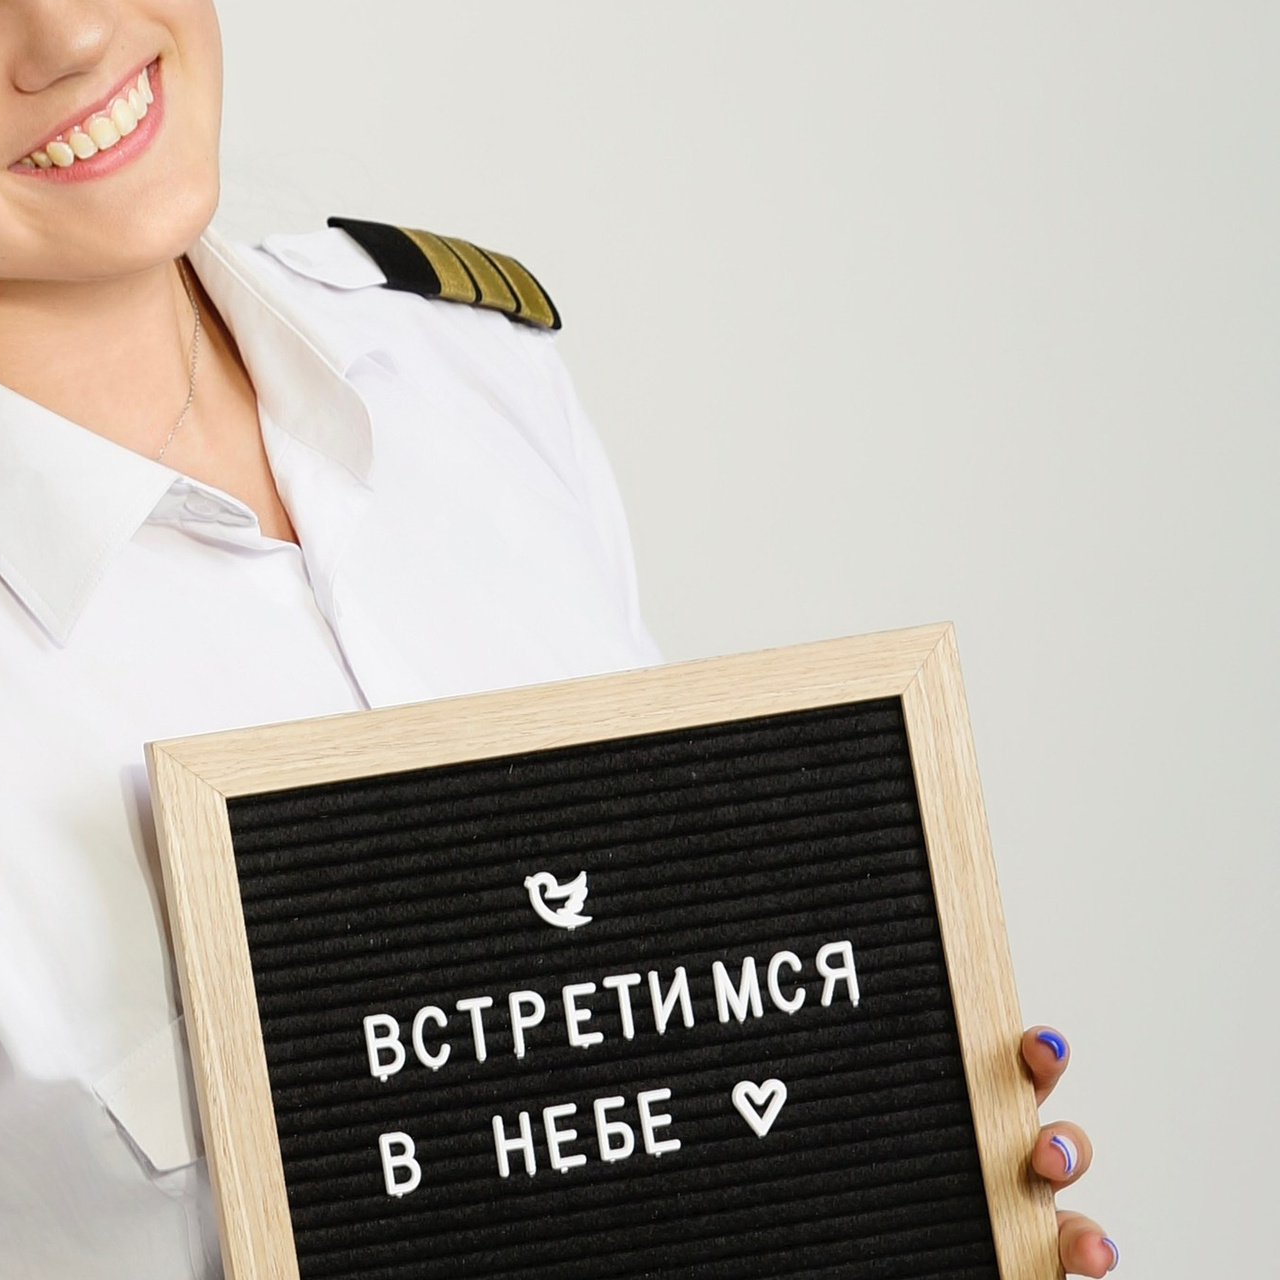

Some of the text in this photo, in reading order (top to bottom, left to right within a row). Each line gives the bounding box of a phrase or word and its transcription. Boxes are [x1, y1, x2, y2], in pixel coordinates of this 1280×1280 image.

[363, 940, 861, 1082] ВСТРЕТИМСЯ
[378, 1087, 682, 1198] В НЕБЕ
